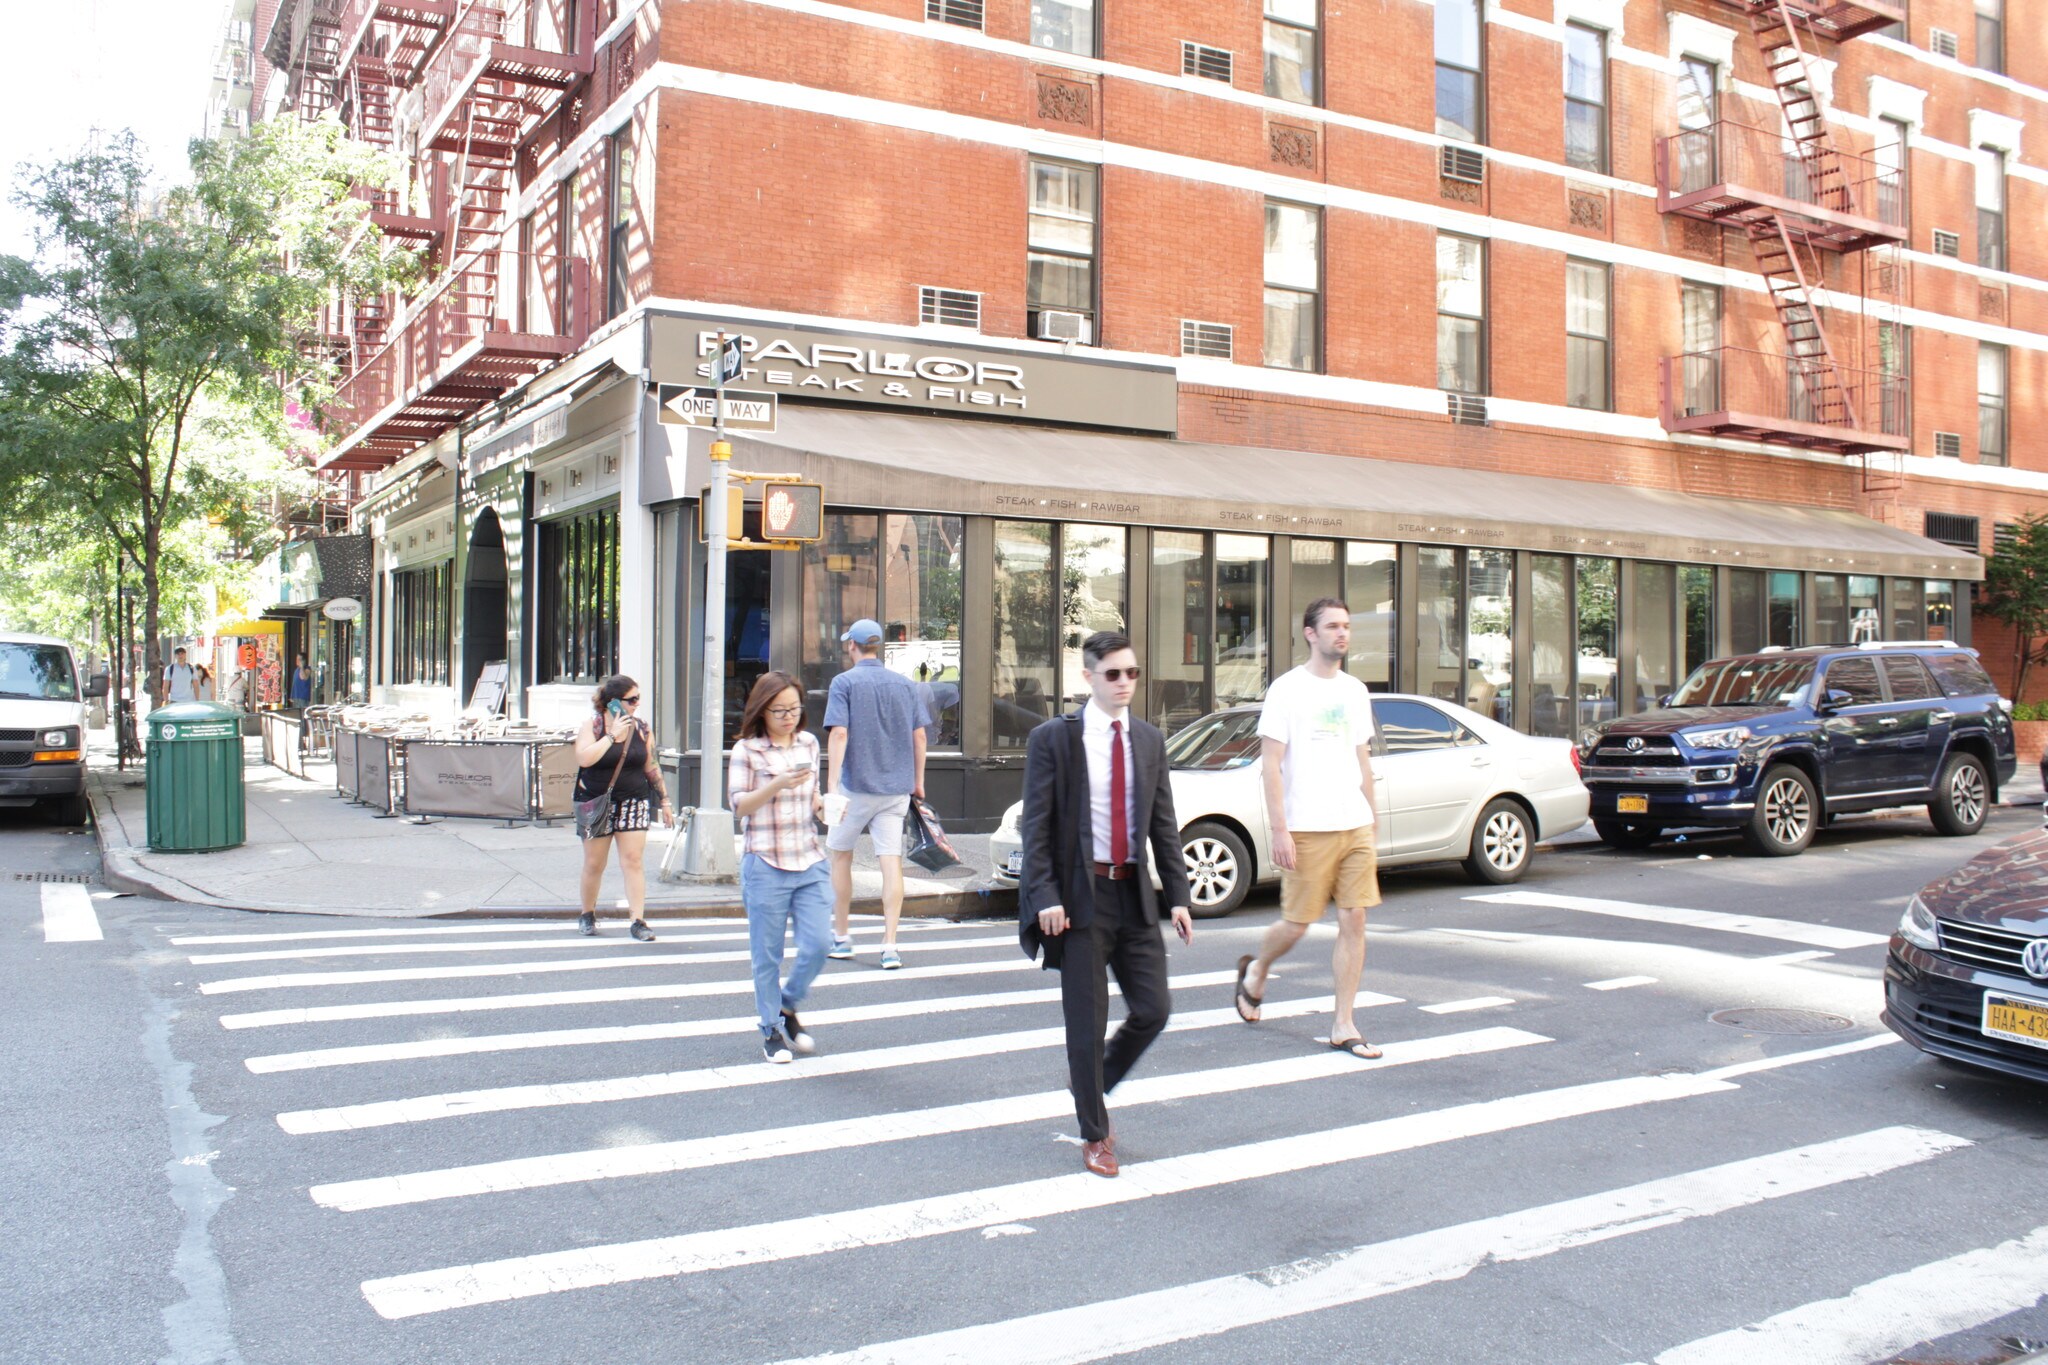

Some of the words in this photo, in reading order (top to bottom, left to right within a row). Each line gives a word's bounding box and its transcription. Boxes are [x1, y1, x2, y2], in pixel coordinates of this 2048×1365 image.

[698, 331, 1025, 390] PARLOR
[884, 382, 912, 398] &
[929, 386, 1027, 409] FISH
[682, 398, 714, 415] ONE
[730, 402, 763, 419] WAY
[995, 495, 1035, 506] STEAK
[1050, 499, 1077, 509] FISH
[1091, 502, 1140, 514] RAWBAR
[1219, 511, 1254, 521] STEAK
[1265, 514, 1289, 523] FISH
[1301, 516, 1343, 527] RAWBAR
[1397, 523, 1428, 533] STEAK
[1437, 526, 1458, 534] FISH
[1467, 528, 1505, 538] RAWBAR
[1552, 535, 1579, 544] STEAK
[438, 773, 492, 782] PARLOR
